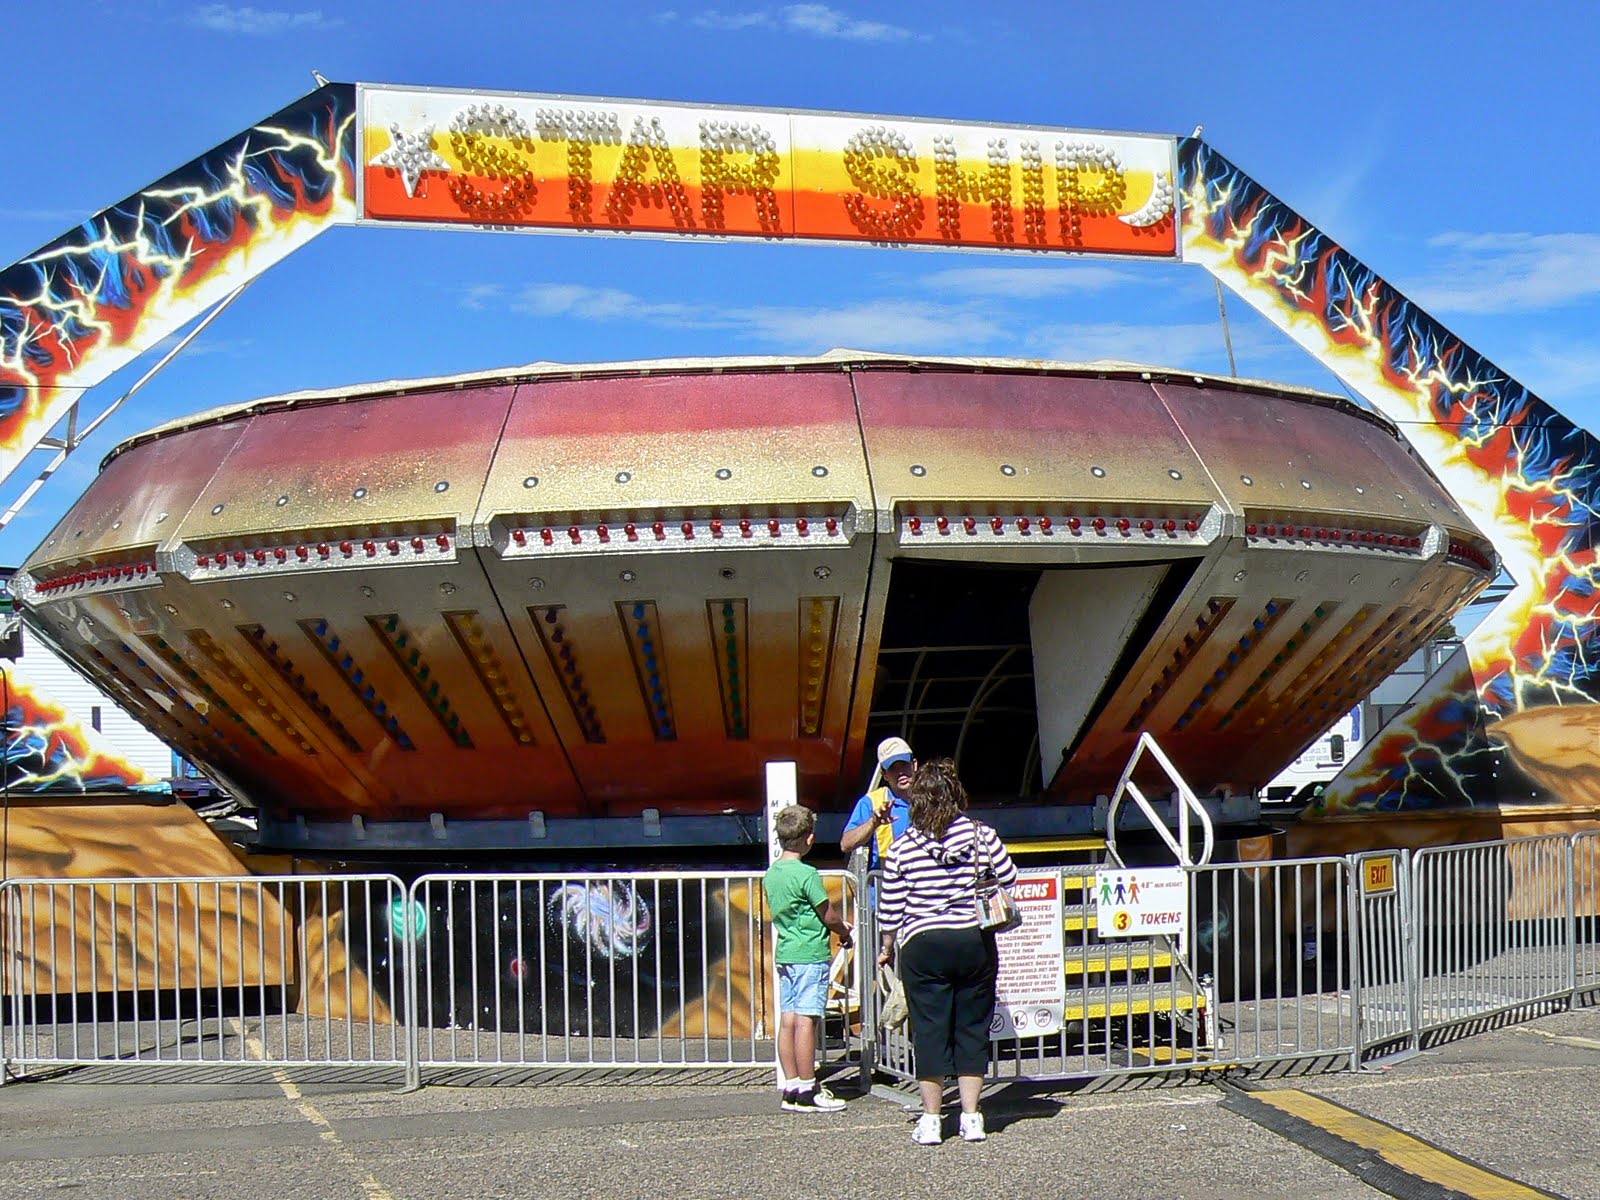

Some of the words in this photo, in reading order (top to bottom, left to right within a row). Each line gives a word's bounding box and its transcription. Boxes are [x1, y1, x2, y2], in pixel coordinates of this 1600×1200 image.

[447, 102, 781, 222] STAR
[843, 125, 1125, 237] SHIP
[1371, 865, 1387, 885] EXIT
[1006, 882, 1050, 900] OKENS
[1117, 913, 1128, 931] 3
[1140, 912, 1182, 926] TOKENS
